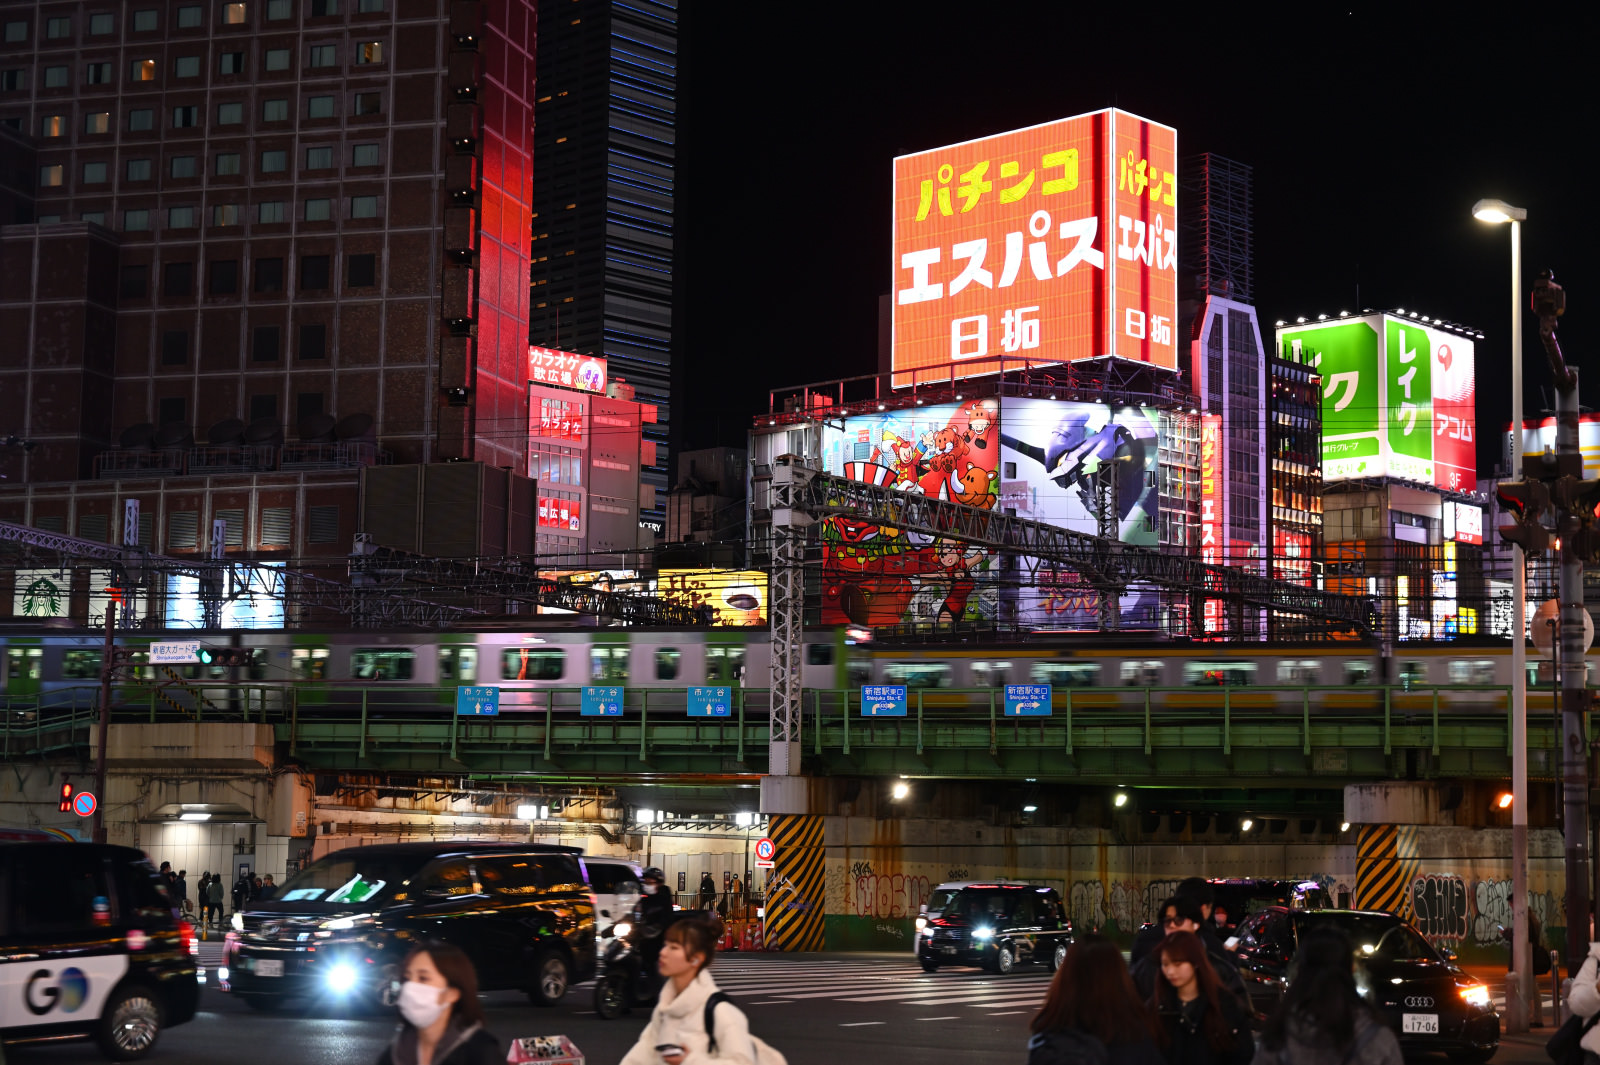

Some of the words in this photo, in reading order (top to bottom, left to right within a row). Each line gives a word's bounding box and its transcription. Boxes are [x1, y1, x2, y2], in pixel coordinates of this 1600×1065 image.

[915, 148, 1079, 221] パチンコ
[1119, 149, 1176, 207] パチンコ
[898, 209, 1105, 305] エスパス
[1118, 213, 1176, 273] エスパス
[951, 305, 1040, 360] 日拓
[1125, 308, 1171, 346] 日拓
[530, 348, 580, 370] カラオケ
[533, 366, 572, 385] 歌広場
[1290, 338, 1359, 413] レク
[1398, 329, 1417, 436] レイク
[542, 419, 582, 433] カラオケ
[1436, 413, 1473, 443] アコム
[1201, 426, 1215, 495] パチンコ
[1449, 472, 1462, 487] 3F
[539, 507, 569, 520] 歌広場
[865, 686, 904, 696] 新宿駅東口
[1008, 686, 1048, 695] 新宿駅東口
[25, 967, 89, 1015] GO
